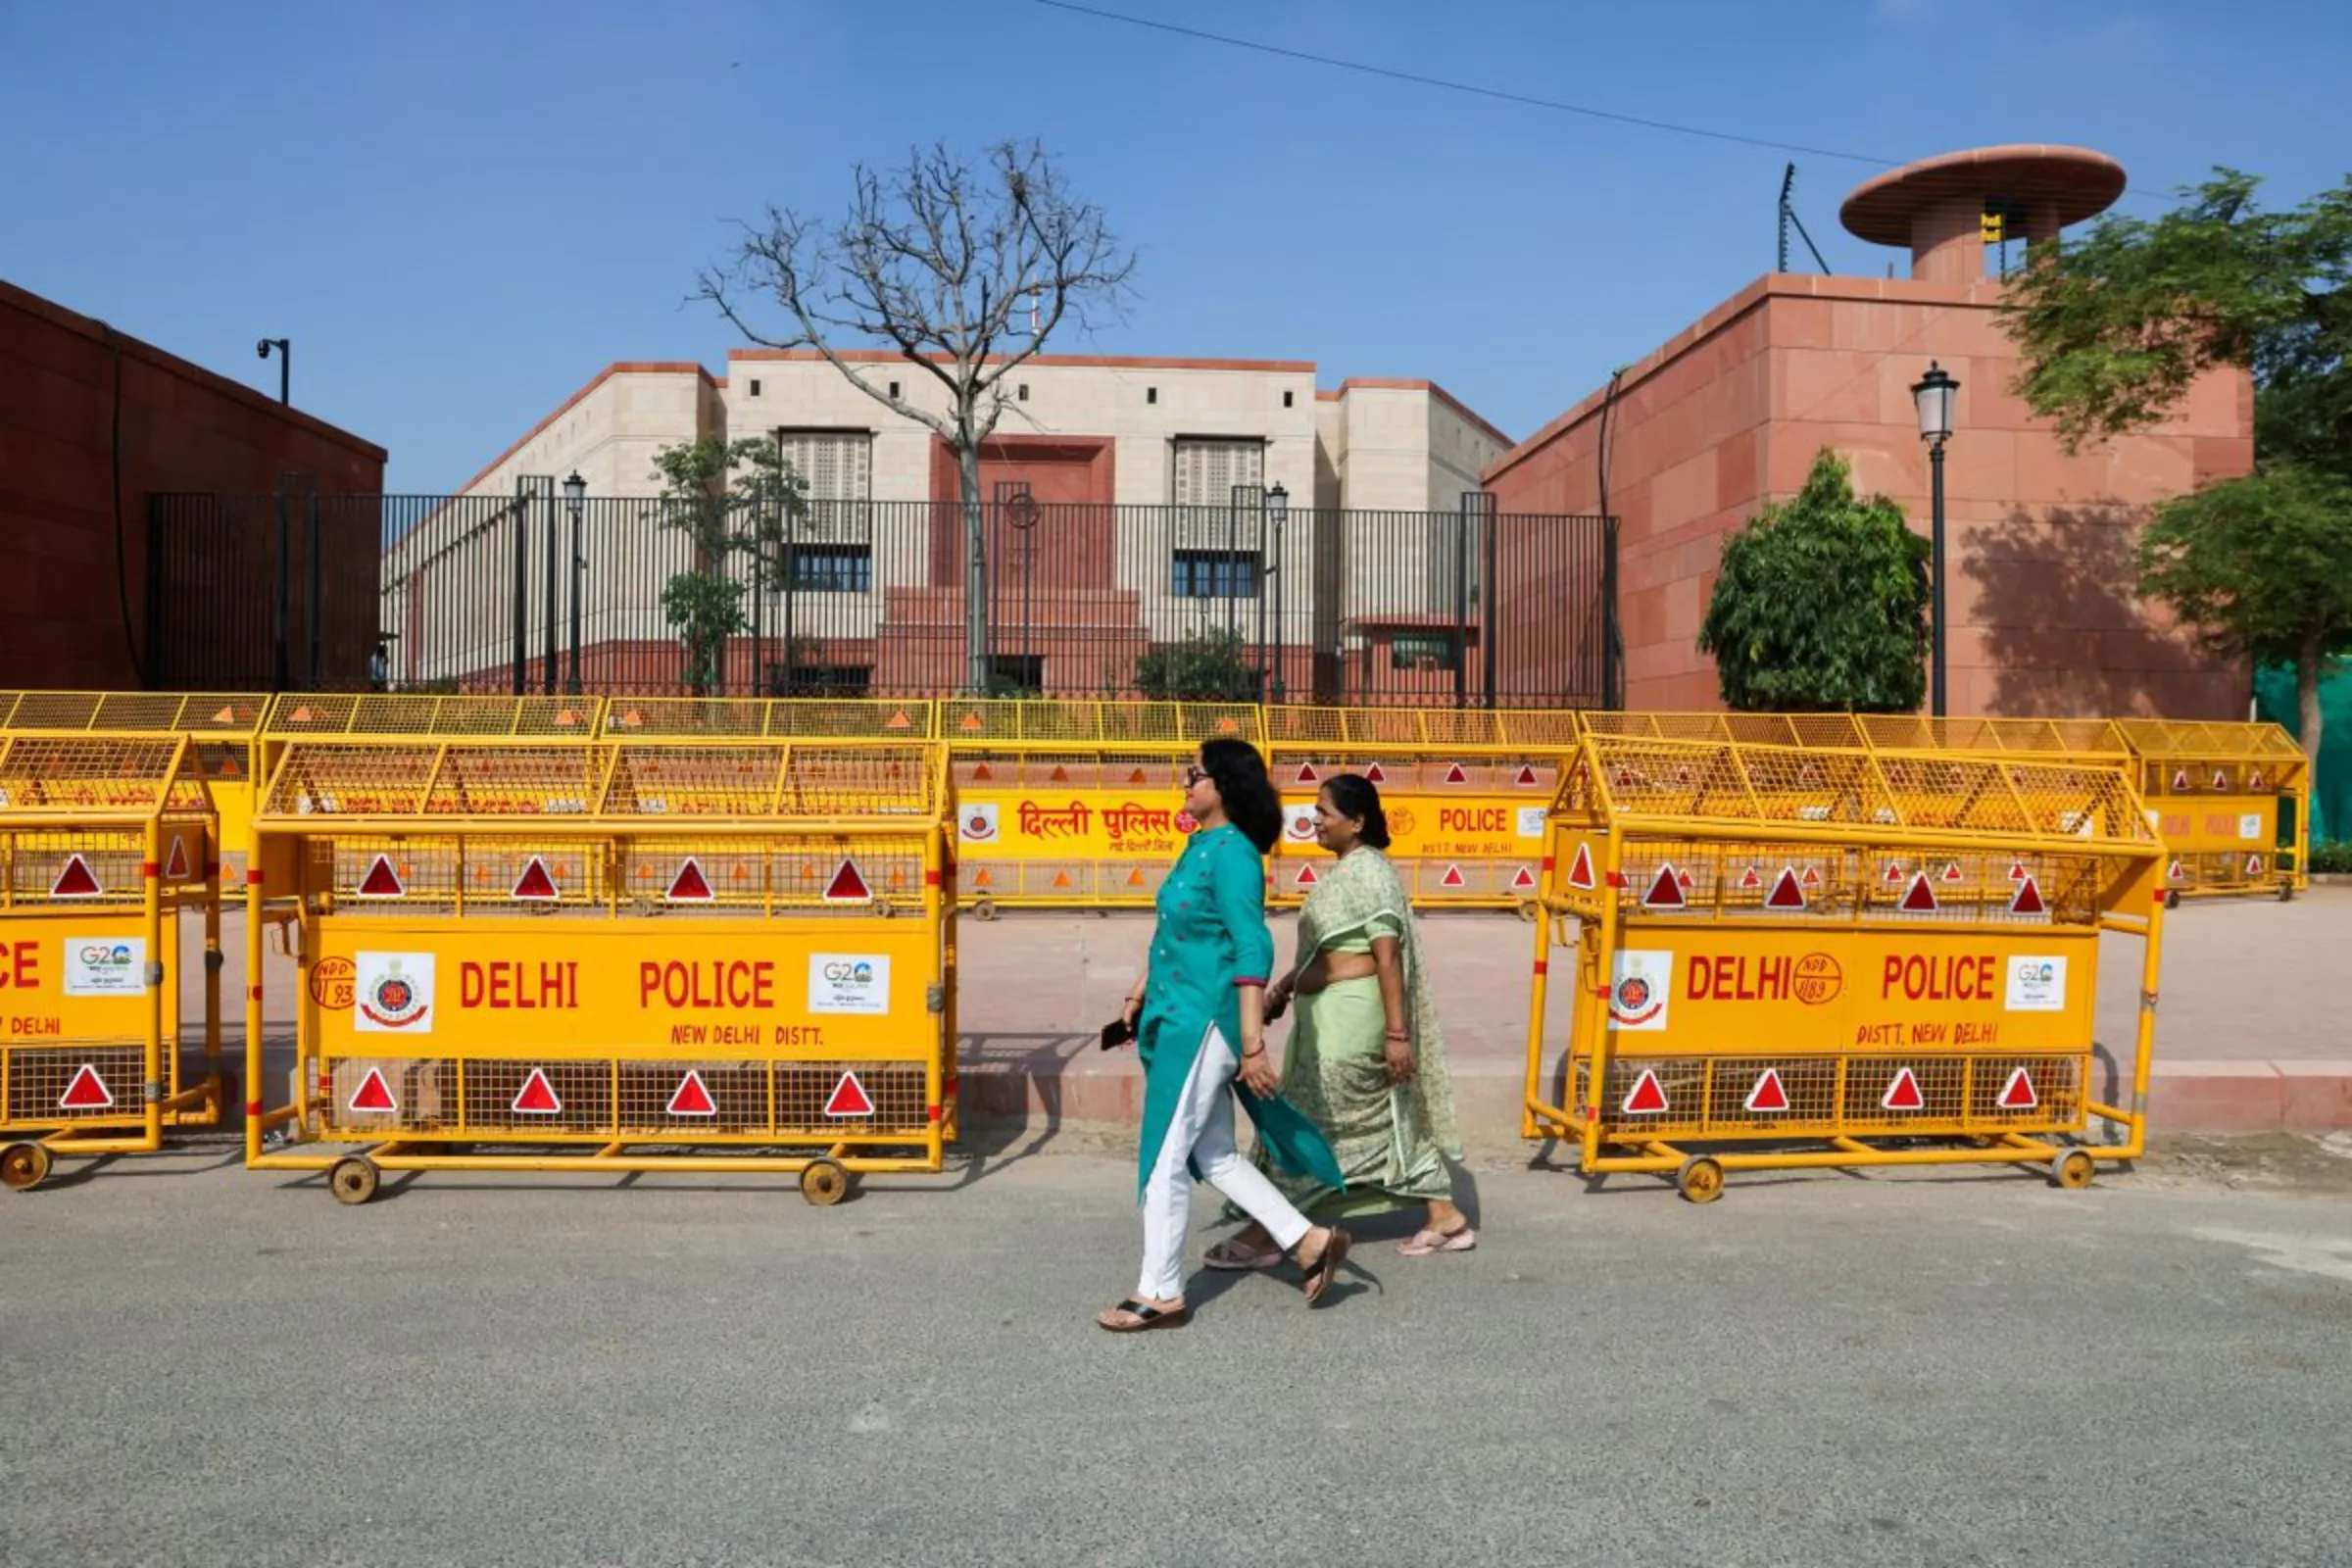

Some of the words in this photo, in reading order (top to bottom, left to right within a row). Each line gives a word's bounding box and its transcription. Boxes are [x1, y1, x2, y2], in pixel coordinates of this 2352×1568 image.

[1016, 800, 1094, 840] दिल्ली
[1101, 802, 1171, 840] पुलिस
[1440, 808, 1507, 832] POLICE
[80, 944, 131, 965] G20
[823, 961, 872, 983] G20
[1686, 956, 1792, 1001] DELHI
[1882, 955, 1996, 1001] POLICE
[461, 960, 579, 1008] DELHI
[640, 960, 775, 1009] POLICE
[11, 1016, 60, 1035] DELHI
[671, 1025, 708, 1045] NEW
[713, 1025, 760, 1046] DELHI
[1912, 1023, 1947, 1045] NEW
[1953, 1022, 1997, 1046] DELHI
